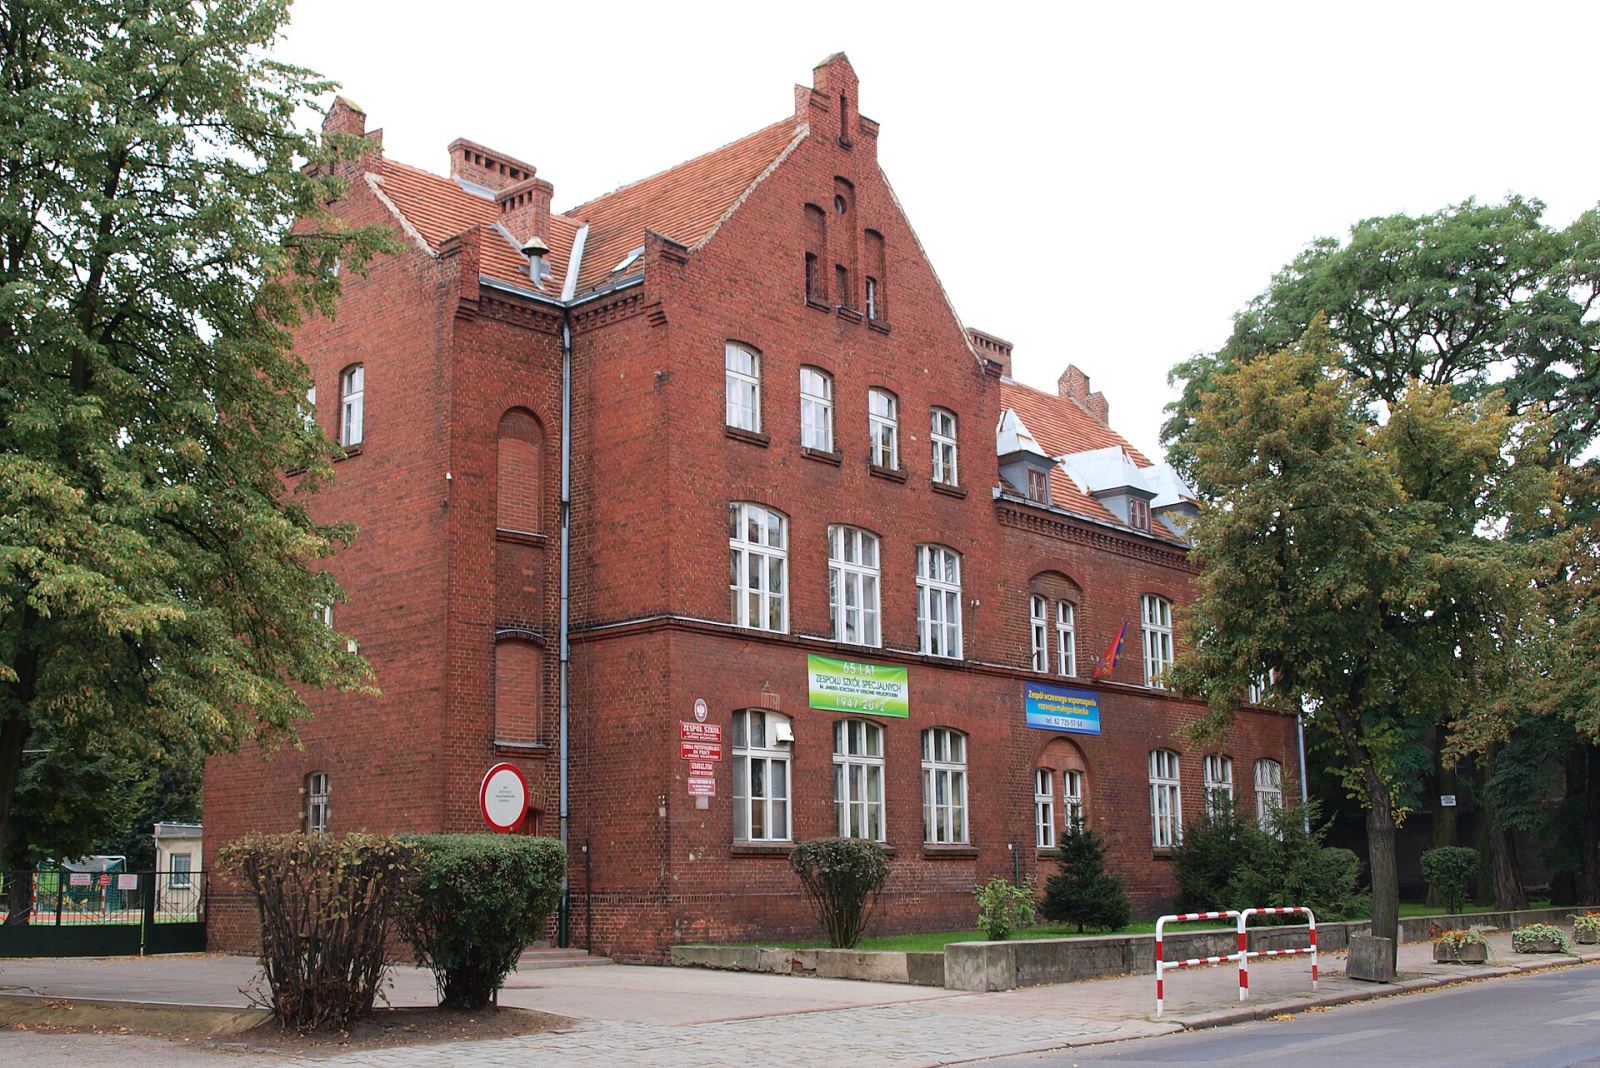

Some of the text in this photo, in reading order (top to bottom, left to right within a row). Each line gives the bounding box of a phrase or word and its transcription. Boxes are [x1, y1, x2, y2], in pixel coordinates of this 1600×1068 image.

[843, 662, 875, 677] 65 LAT
[842, 676, 860, 688] SZKÓŁ
[862, 680, 902, 693] SPECJALNYCH
